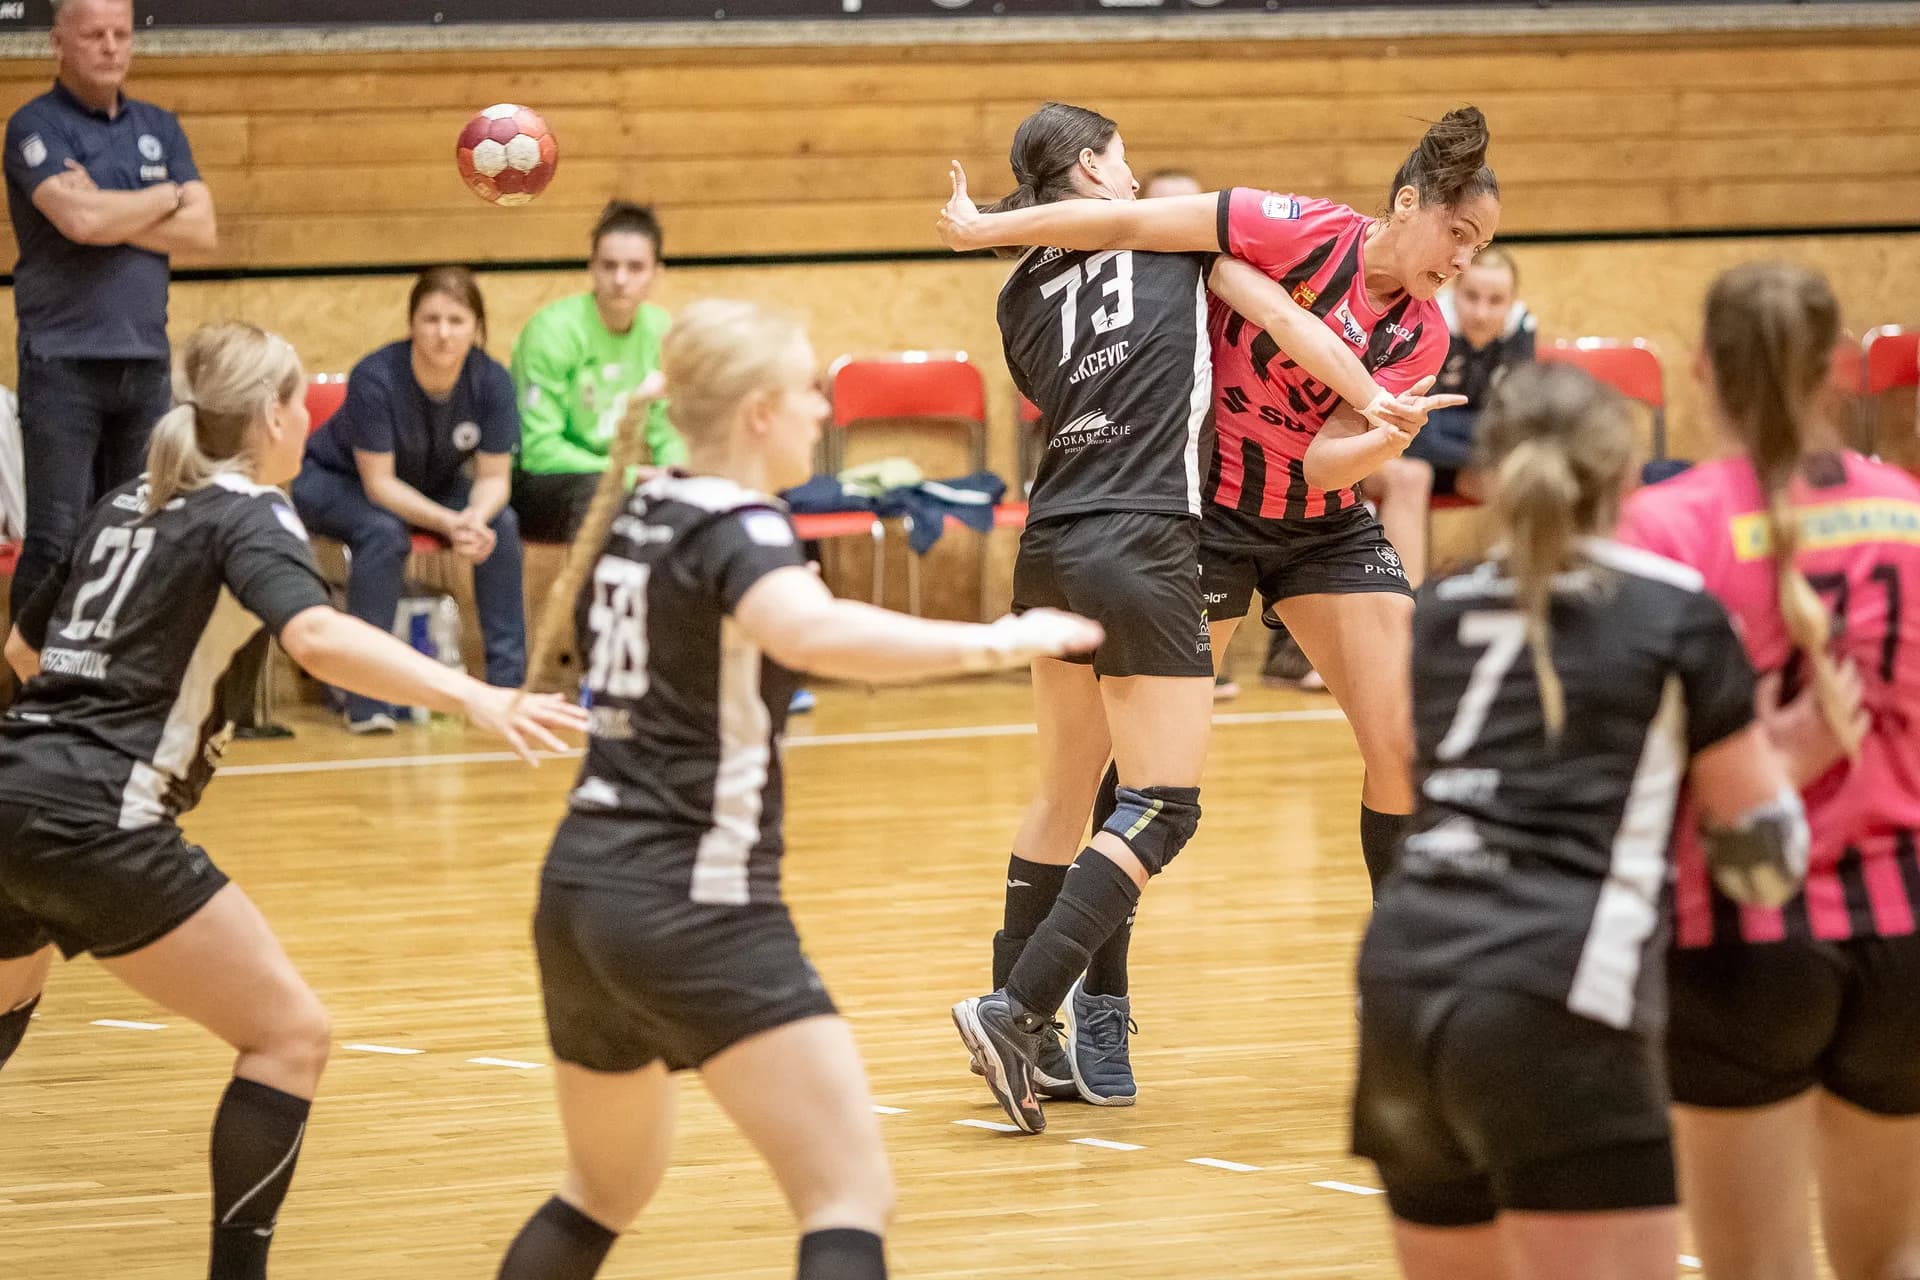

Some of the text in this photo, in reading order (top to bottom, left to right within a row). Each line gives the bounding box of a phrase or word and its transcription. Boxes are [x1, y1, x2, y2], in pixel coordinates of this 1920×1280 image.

[1039, 249, 1134, 367] 73
[59, 526, 156, 640] 21
[1435, 610, 1528, 761] 7
